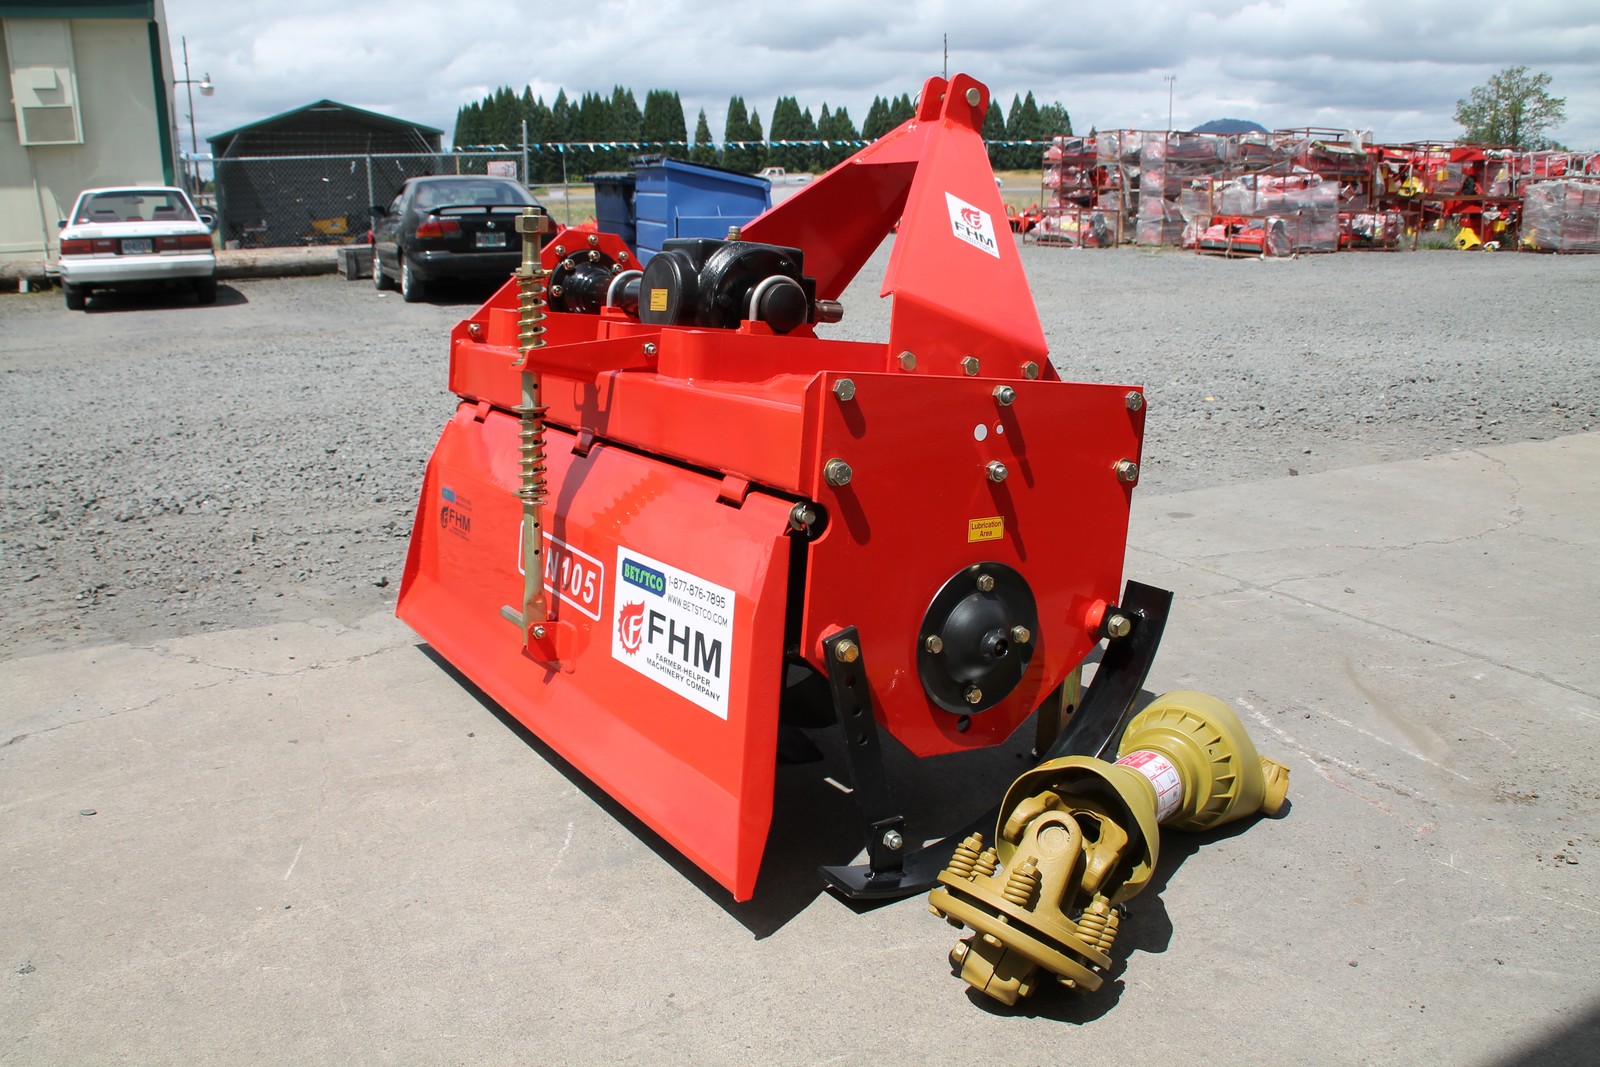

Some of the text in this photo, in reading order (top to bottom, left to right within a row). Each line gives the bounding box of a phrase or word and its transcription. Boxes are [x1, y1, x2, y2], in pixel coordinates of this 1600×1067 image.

[955, 221, 994, 249] FHM
[449, 508, 471, 533] FHM
[971, 521, 1002, 530] Lubrication
[624, 562, 664, 592] BETSTCO
[668, 575, 726, 609] 1-877-876-7895
[667, 593, 728, 627] WWW.BETSTCO.COM
[647, 609, 722, 679] FHM
[646, 657, 721, 702] MACHINERY COMPANY
[655, 653, 711, 687] FARMER-HELPER
